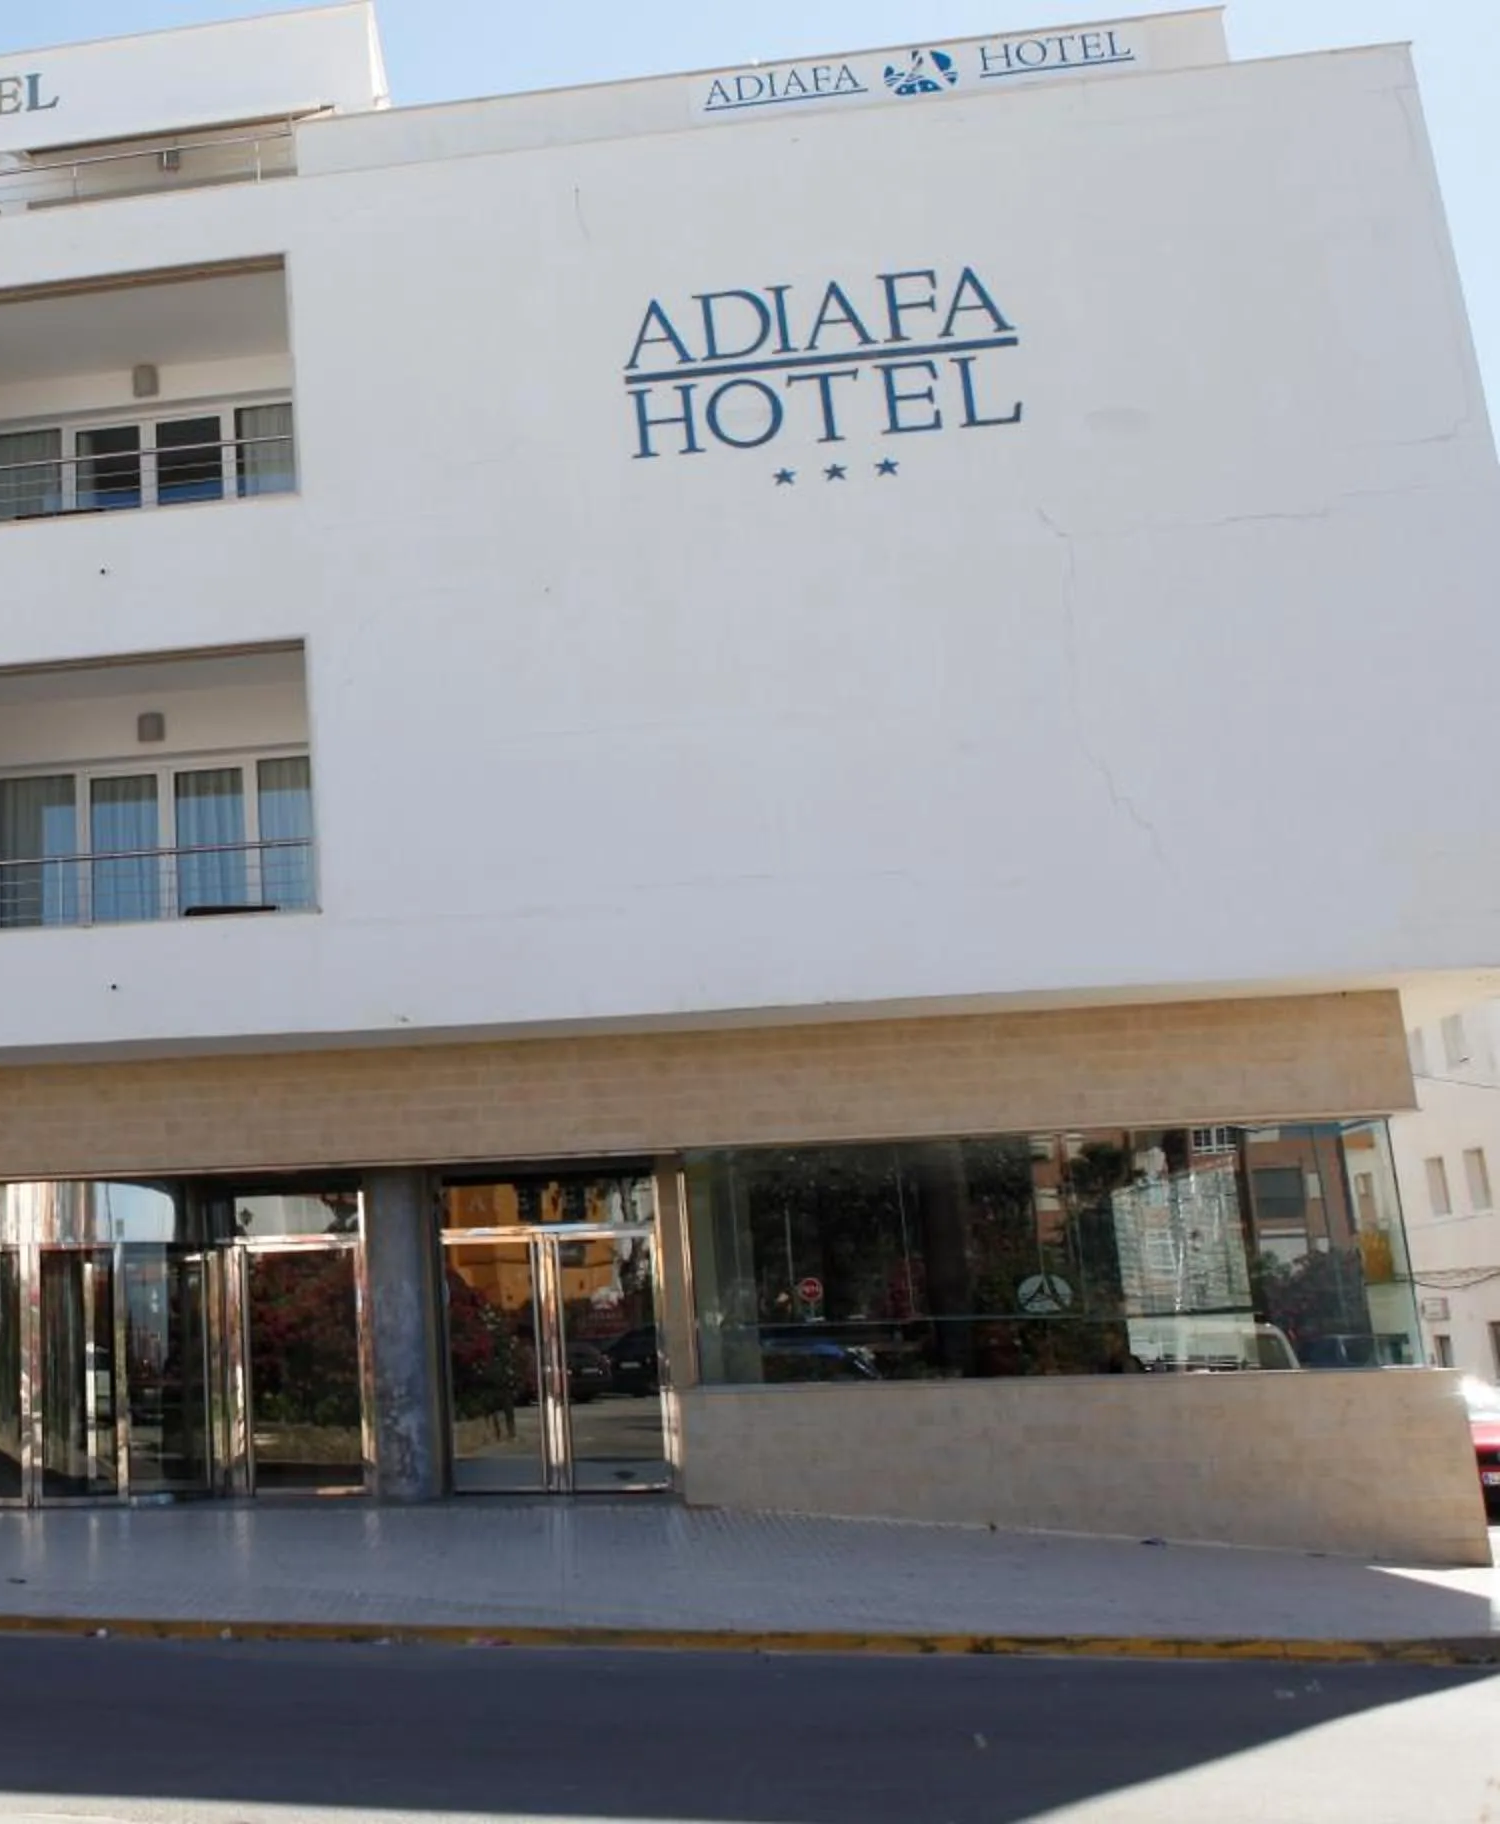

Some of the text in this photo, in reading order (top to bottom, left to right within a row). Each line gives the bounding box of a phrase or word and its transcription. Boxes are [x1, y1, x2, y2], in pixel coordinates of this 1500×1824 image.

[704, 30, 1132, 107] ADIAFA HOTEL
[623, 266, 1016, 371] ADIAFA
[627, 355, 1024, 459] HOTEL
